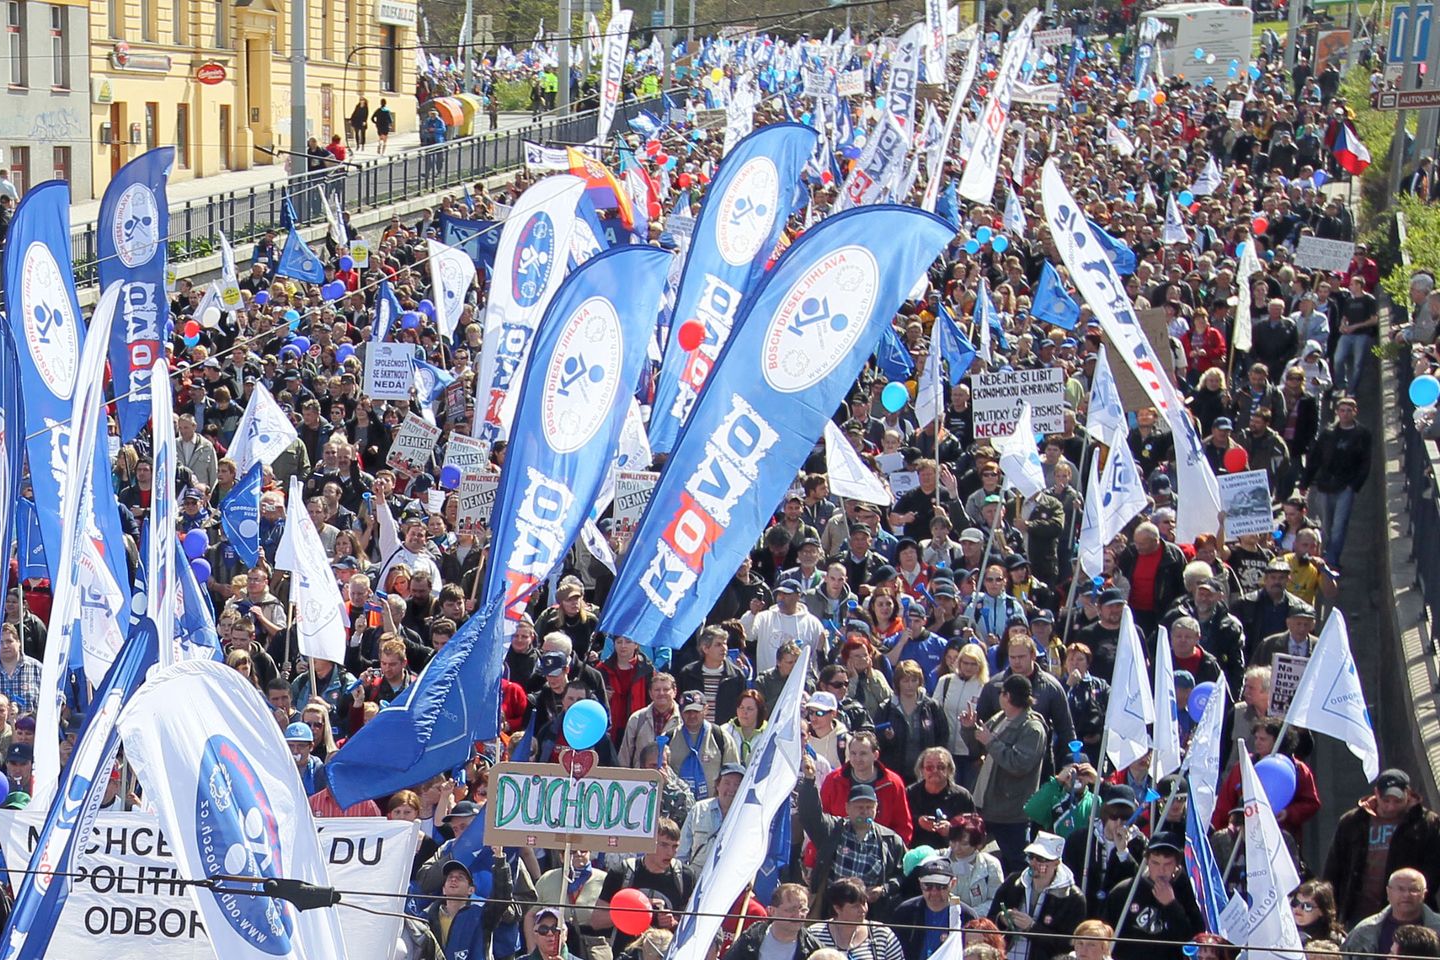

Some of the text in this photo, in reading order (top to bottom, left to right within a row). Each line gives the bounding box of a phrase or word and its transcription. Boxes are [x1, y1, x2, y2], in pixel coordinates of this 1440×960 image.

[767, 253, 848, 370] BOSCH DIESEL JIHLAVA
[125, 284, 155, 402] KOVO
[375, 357, 408, 368] SPOLEČNOST
[373, 371, 381, 379] SE
[546, 307, 591, 437] BOSCH DIESEL JIHLAVA
[980, 373, 1017, 386] NEDEJME
[1021, 372, 1030, 383] SI
[374, 379, 406, 389] NEDÁ!
[1021, 382, 1063, 396] NEMRAVNOST
[398, 435, 433, 450] DEMISI!
[447, 452, 485, 465] DEMISI!
[462, 491, 497, 510] DEMISI
[618, 488, 652, 509] DEMIS
[646, 412, 765, 602] KOVO
[1278, 663, 1293, 673] Na
[1276, 673, 1299, 682] pivo
[70, 866, 188, 897] POLITI
[85, 906, 208, 939] ODBOR
